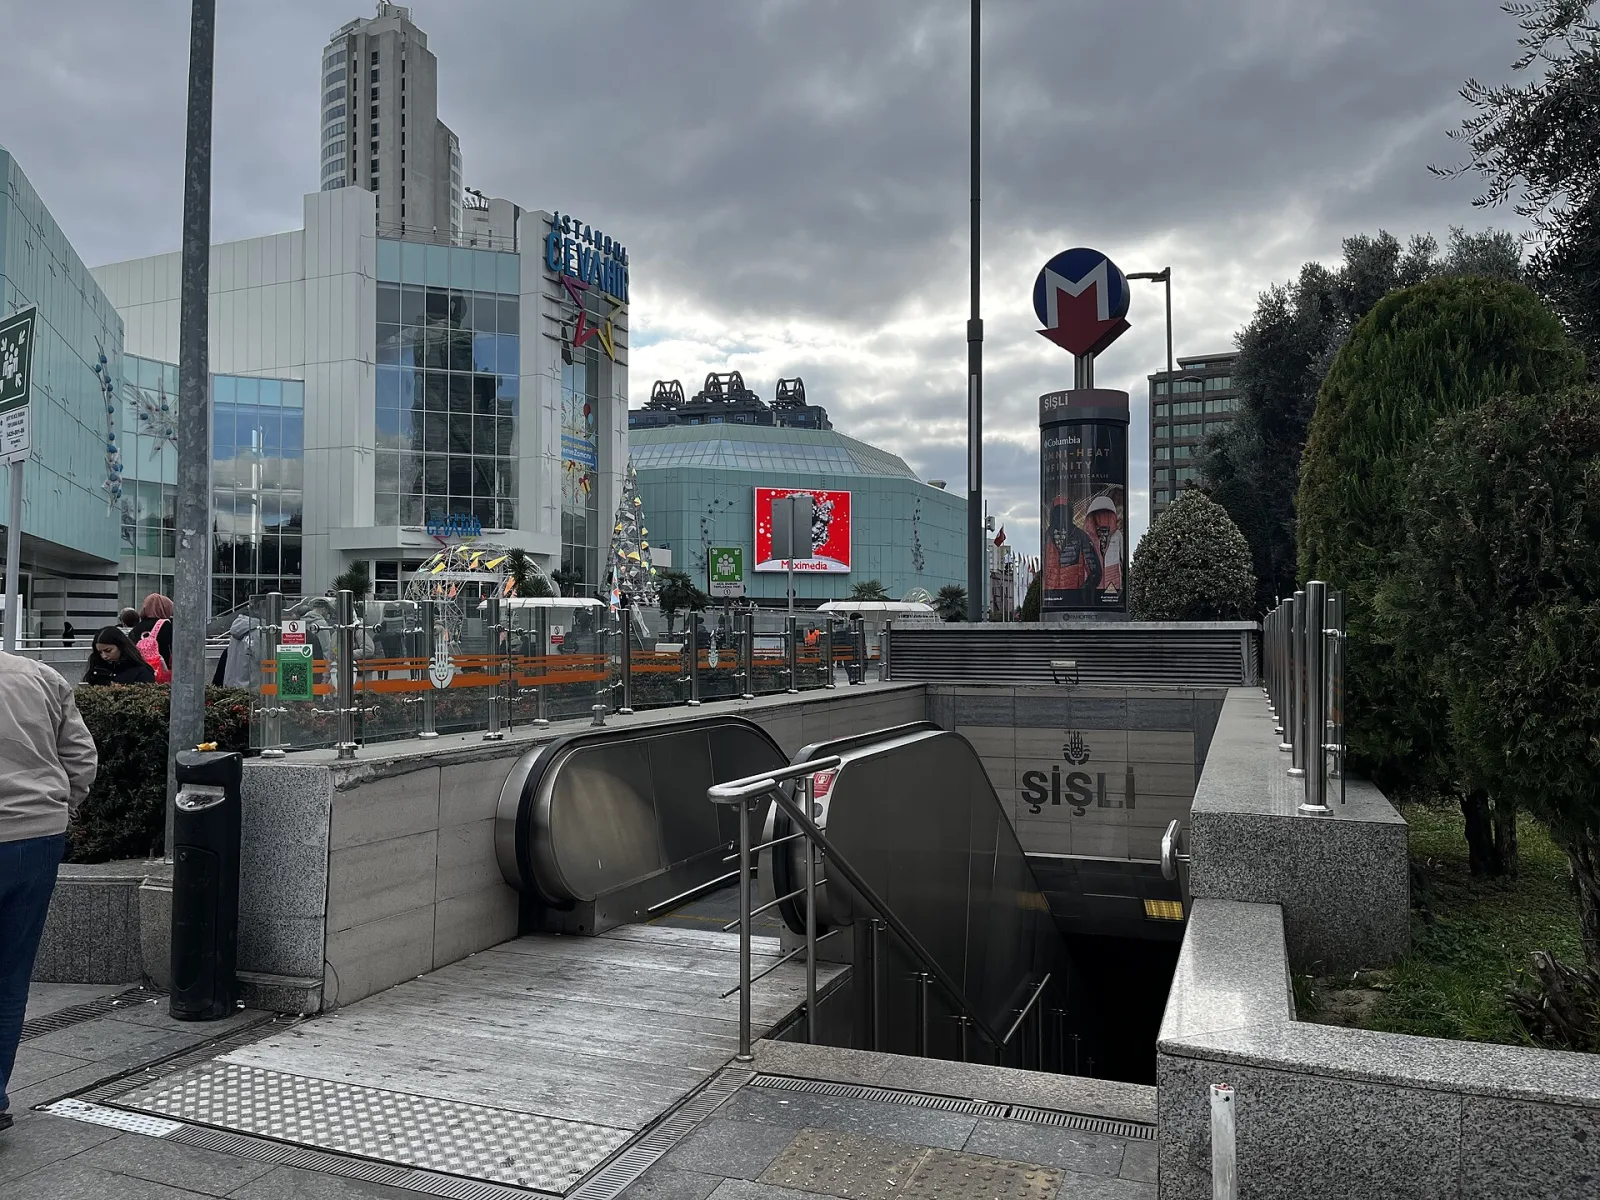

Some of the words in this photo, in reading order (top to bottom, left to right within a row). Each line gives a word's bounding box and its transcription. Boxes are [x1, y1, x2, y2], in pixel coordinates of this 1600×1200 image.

[553, 210, 629, 266] İSTANBUL
[1044, 258, 1110, 329] M
[1047, 436, 1081, 447] Columbia
[780, 560, 828, 571] Mximedia
[1021, 765, 1136, 817] ŞİŞLİ
